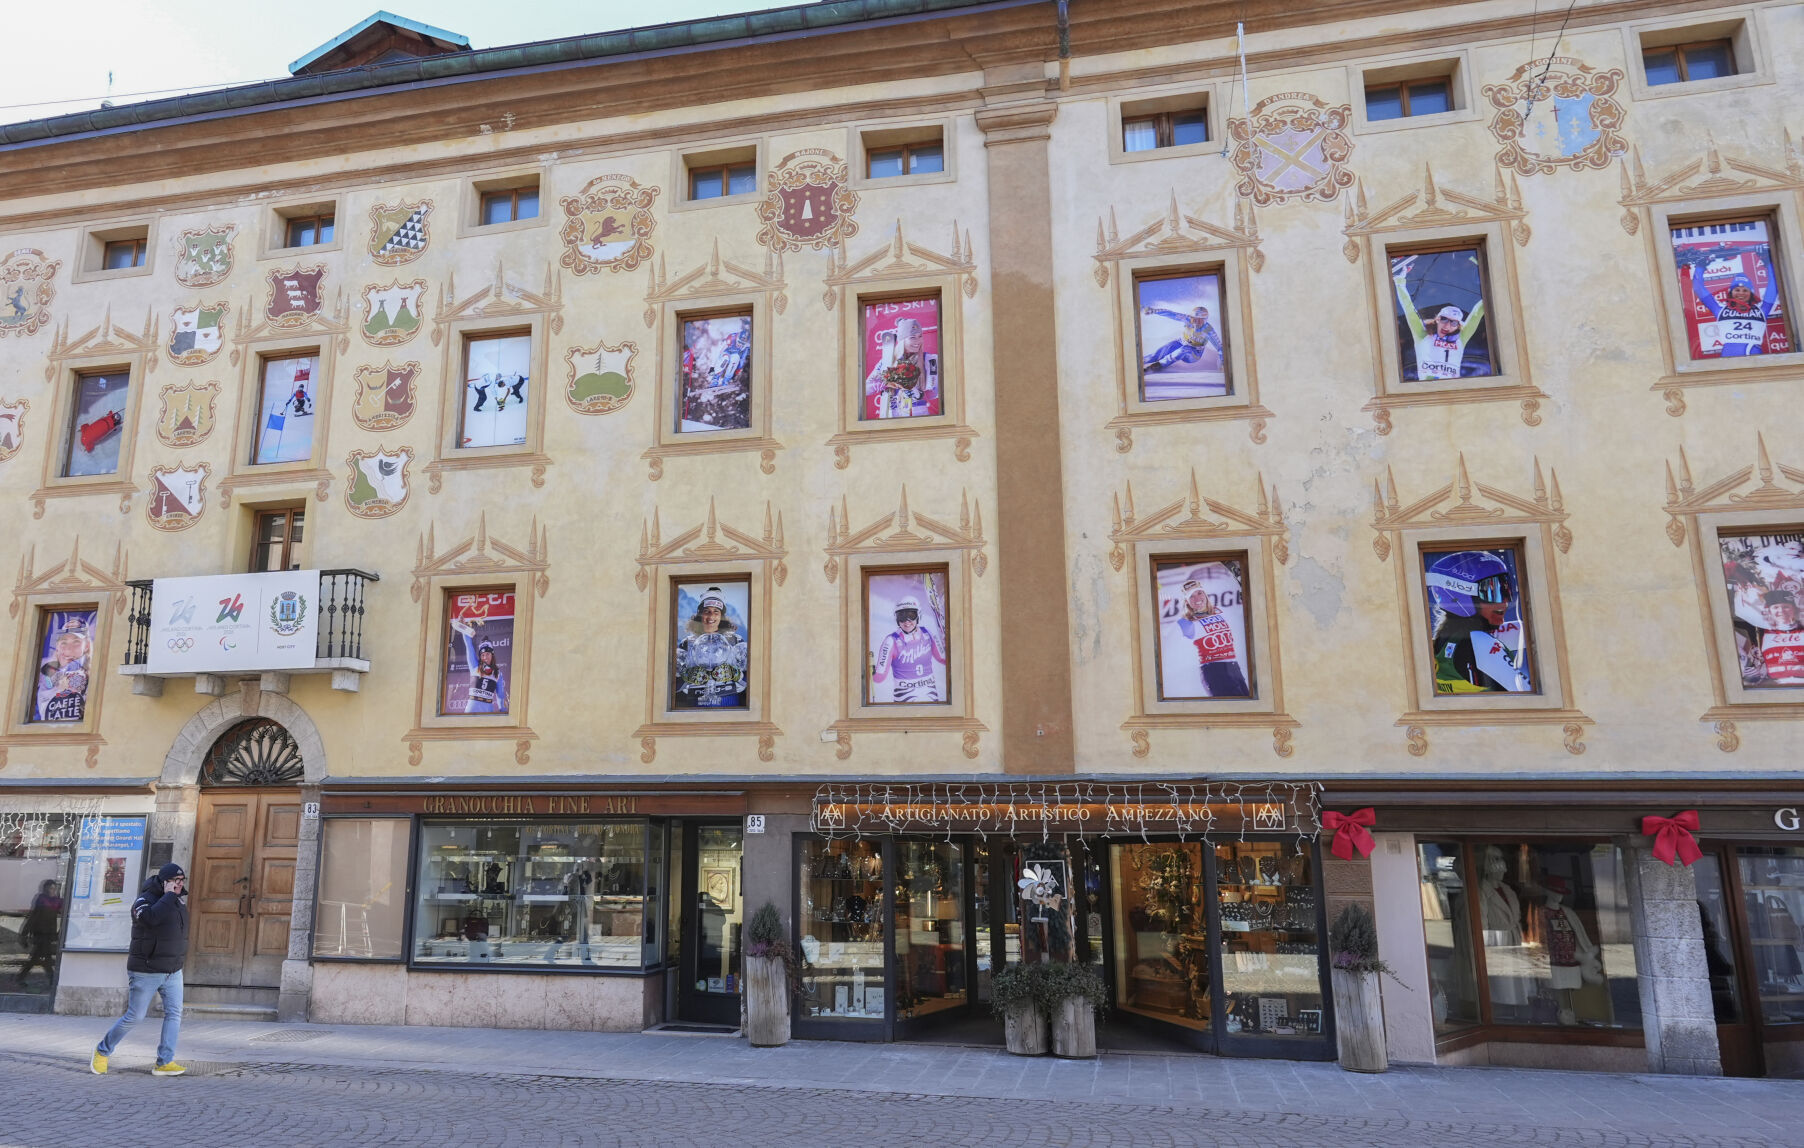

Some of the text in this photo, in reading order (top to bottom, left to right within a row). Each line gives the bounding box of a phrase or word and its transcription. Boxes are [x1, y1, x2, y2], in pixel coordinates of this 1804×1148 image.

[1264, 92, 1311, 105] D'ANDREA
[1733, 321, 1753, 331] 24
[1725, 332, 1761, 341] Cortina
[1444, 349, 1450, 363] 1
[1421, 361, 1457, 375] Cortina
[1205, 621, 1228, 633] MOLY
[879, 646, 889, 667] Audi
[898, 642, 933, 664] Milka
[481, 679, 489, 690] 5
[48, 707, 80, 720] LATTE
[307, 803, 317, 814] 83
[423, 796, 640, 814] GRANOCCHIA FINE ART
[750, 816, 762, 828] 85
[1774, 807, 1801, 831] G
